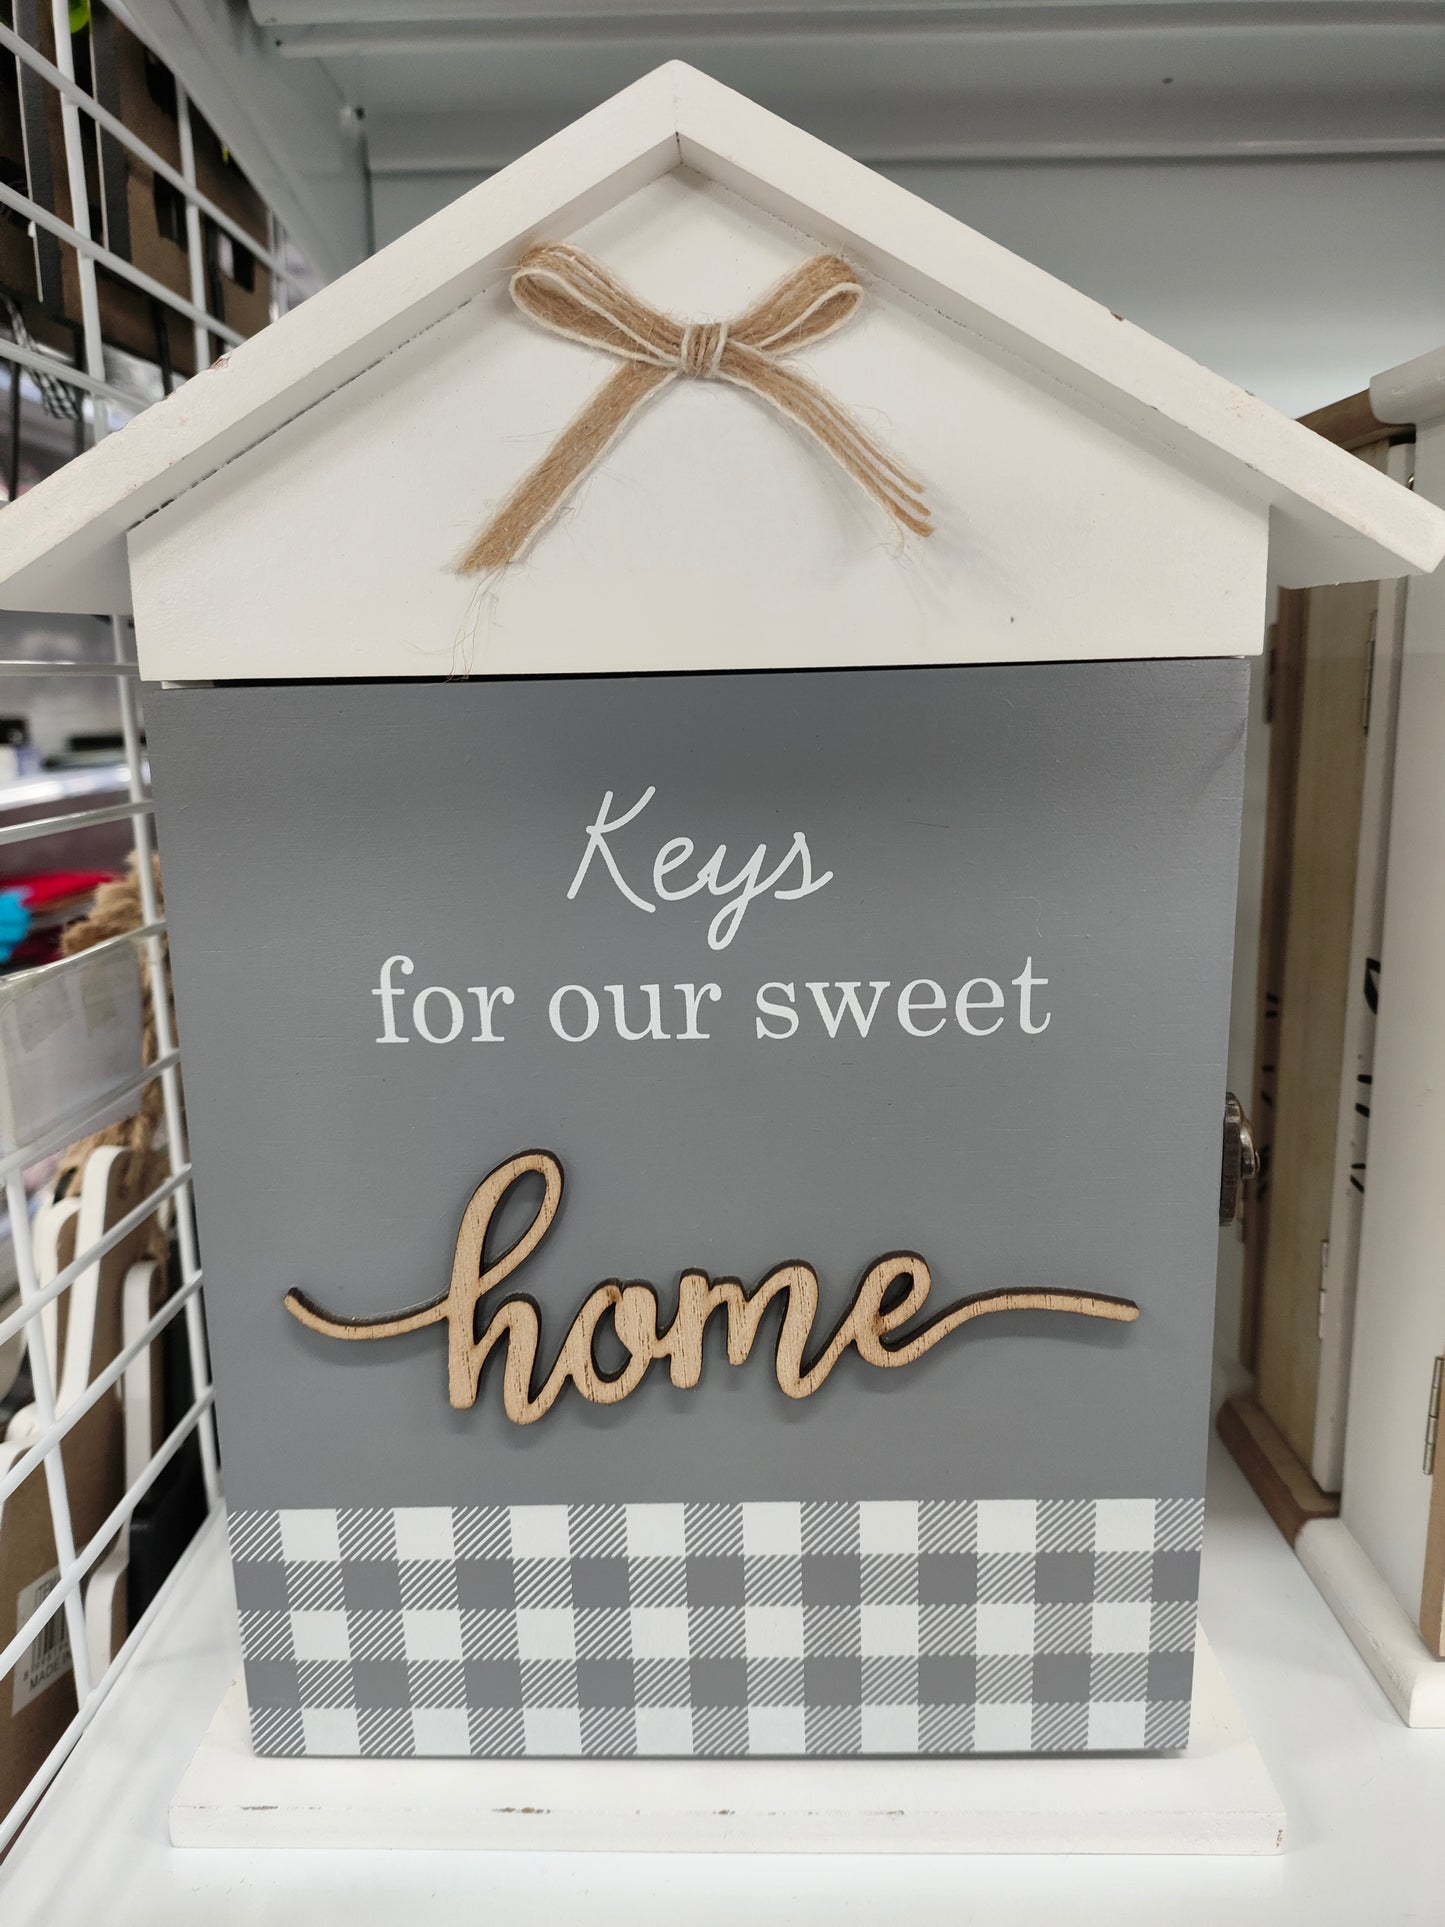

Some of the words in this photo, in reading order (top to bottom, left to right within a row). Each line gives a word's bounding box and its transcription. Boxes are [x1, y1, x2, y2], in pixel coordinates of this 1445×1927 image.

[567, 786, 833, 950] Keys
[372, 955, 514, 1044] for
[549, 983, 721, 1042] our
[756, 956, 1051, 1039] sweet
[284, 1148, 1141, 1425] home
[29, 1661, 61, 1691] MADE
